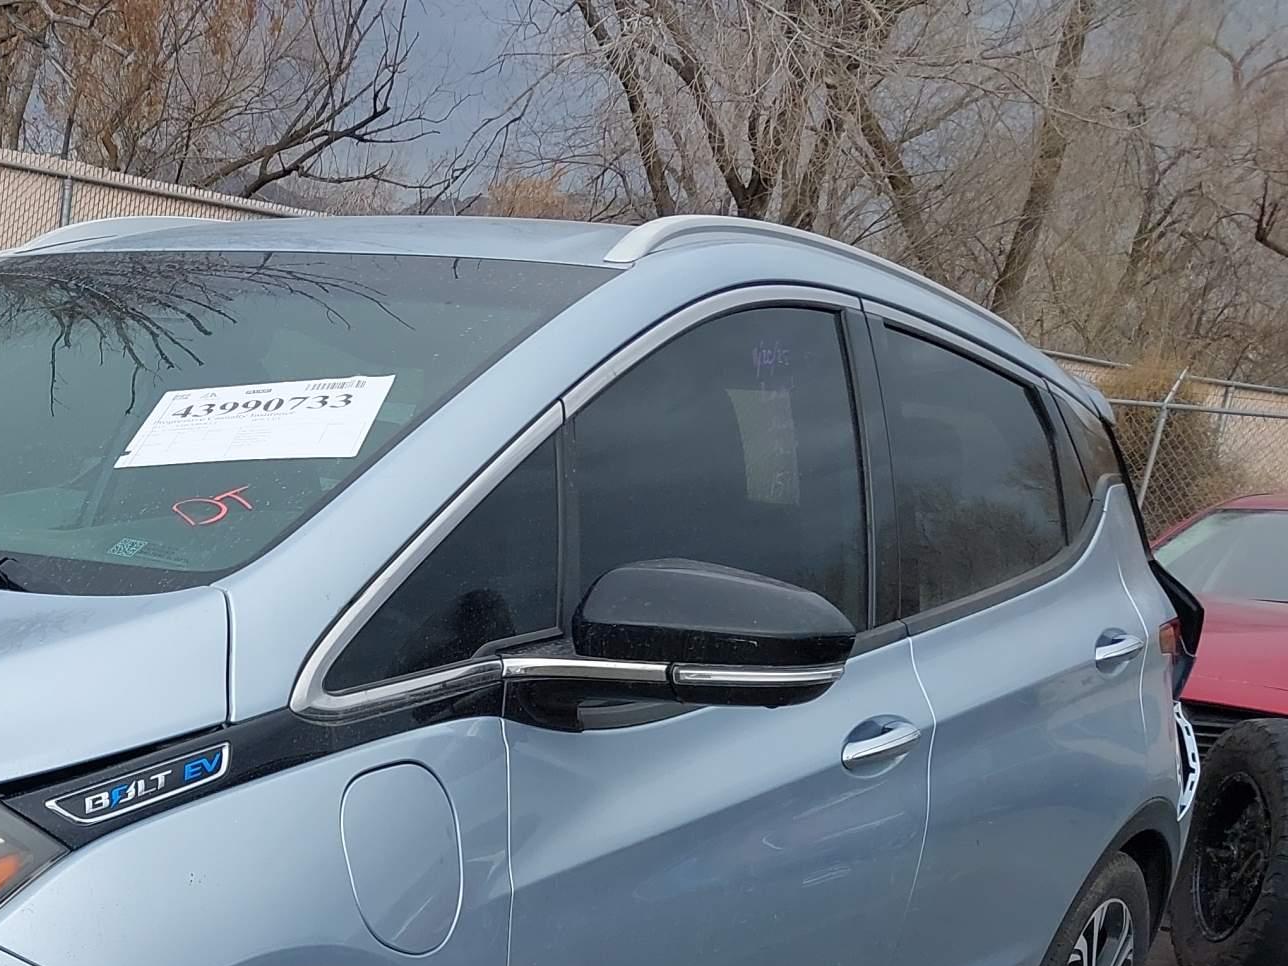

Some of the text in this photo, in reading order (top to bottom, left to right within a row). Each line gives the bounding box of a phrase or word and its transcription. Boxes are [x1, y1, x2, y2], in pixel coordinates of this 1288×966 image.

[171, 393, 354, 419] 43990733
[172, 484, 253, 526] DT
[85, 751, 221, 815] BOLT EV
